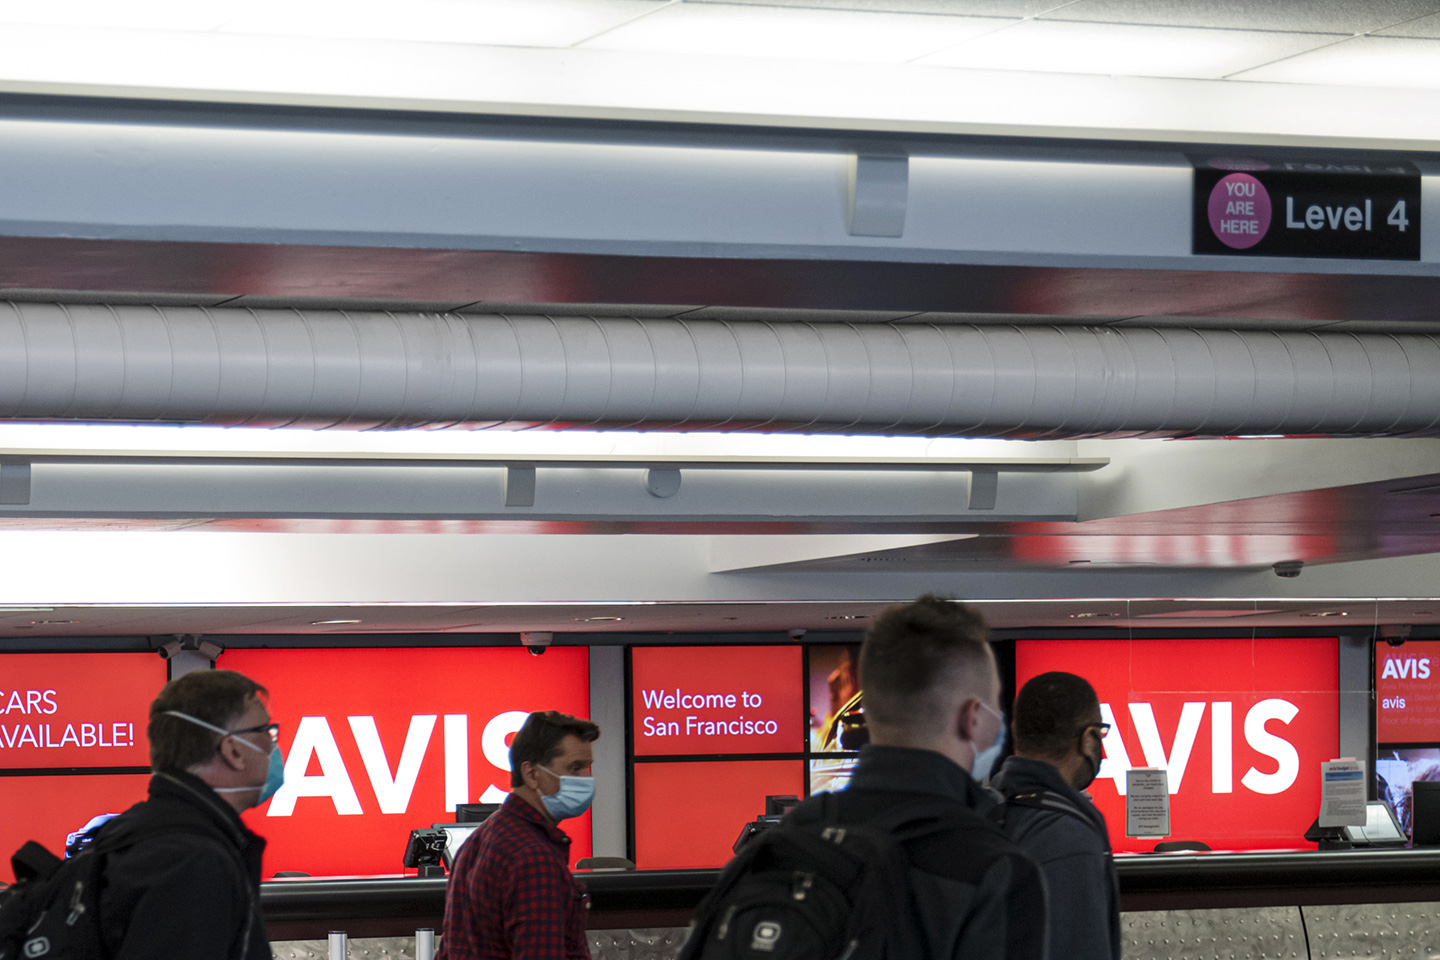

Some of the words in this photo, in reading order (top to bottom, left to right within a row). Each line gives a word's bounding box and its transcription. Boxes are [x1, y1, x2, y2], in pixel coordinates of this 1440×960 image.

[1226, 182, 1255, 197] YOU
[1225, 201, 1255, 216] ARE
[1286, 197, 1372, 231] Level
[1387, 200, 1409, 232] 4
[1220, 220, 1259, 235] HERE
[1382, 658, 1430, 679] AVIS
[642, 688, 736, 709] Welcome
[741, 691, 762, 708] to
[1382, 696, 1406, 709] avis
[643, 716, 679, 736] San
[686, 716, 778, 735] Francisco
